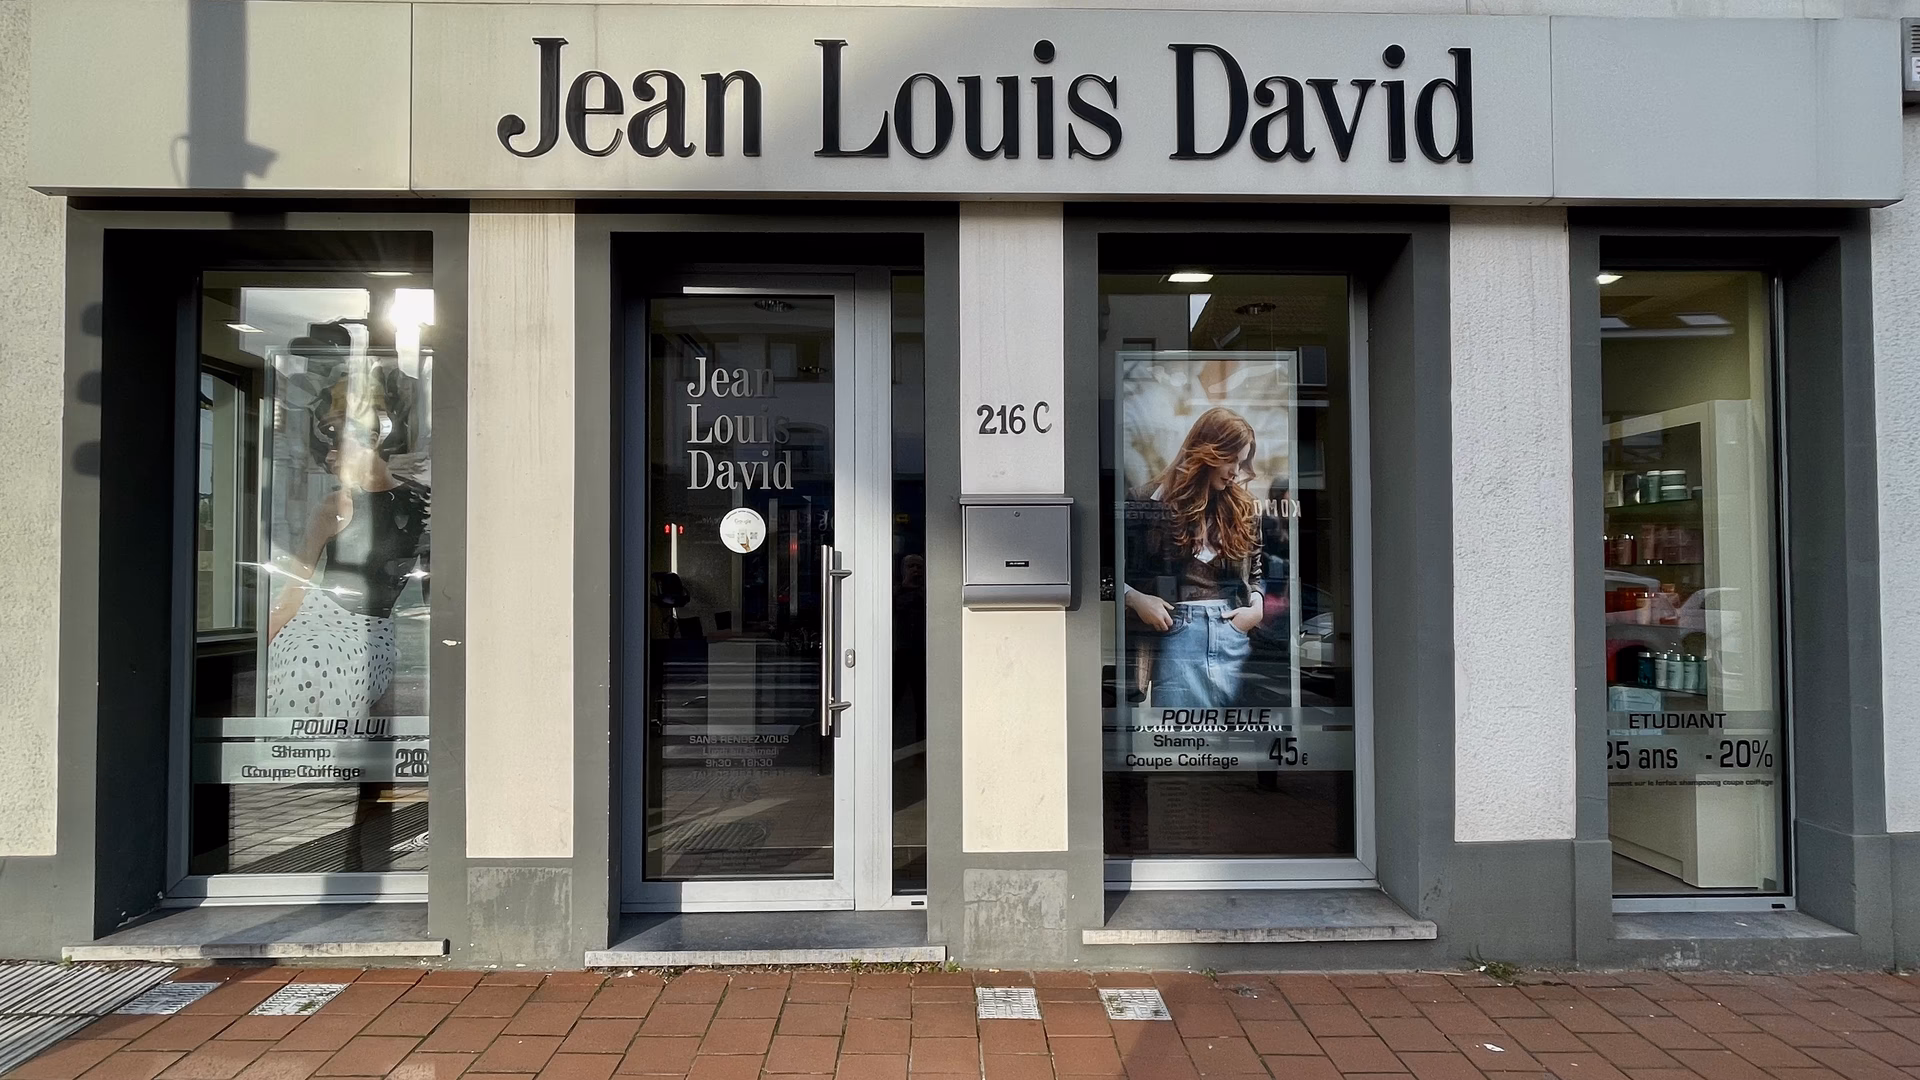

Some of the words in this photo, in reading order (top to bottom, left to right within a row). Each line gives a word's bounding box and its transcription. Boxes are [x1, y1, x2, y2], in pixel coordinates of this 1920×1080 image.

[496, 37, 762, 158] Jean
[813, 38, 1122, 160] Louis
[1168, 42, 1475, 163] David
[687, 357, 778, 398] Jean
[687, 403, 790, 444] Louis
[976, 404, 1026, 434] 216
[1033, 401, 1052, 434] C
[687, 450, 794, 490] David
[1161, 709, 1219, 725] POUR
[1224, 708, 1271, 725] ELLE
[1629, 713, 1727, 729] ETUDIANT
[290, 719, 349, 735] POUR
[353, 719, 387, 735] LUI
[689, 735, 718, 744] SANS
[1153, 735, 1209, 749] Shamp.
[271, 745, 335, 761] Shamp.
[1125, 753, 1173, 769] Coupe
[1177, 752, 1239, 769] Coiffage
[1638, 748, 1678, 769] ans
[705, 759, 731, 767] 9h30
[741, 758, 773, 767] 18h30
[241, 765, 291, 781] Coupe
[296, 764, 361, 781] Coiffage
